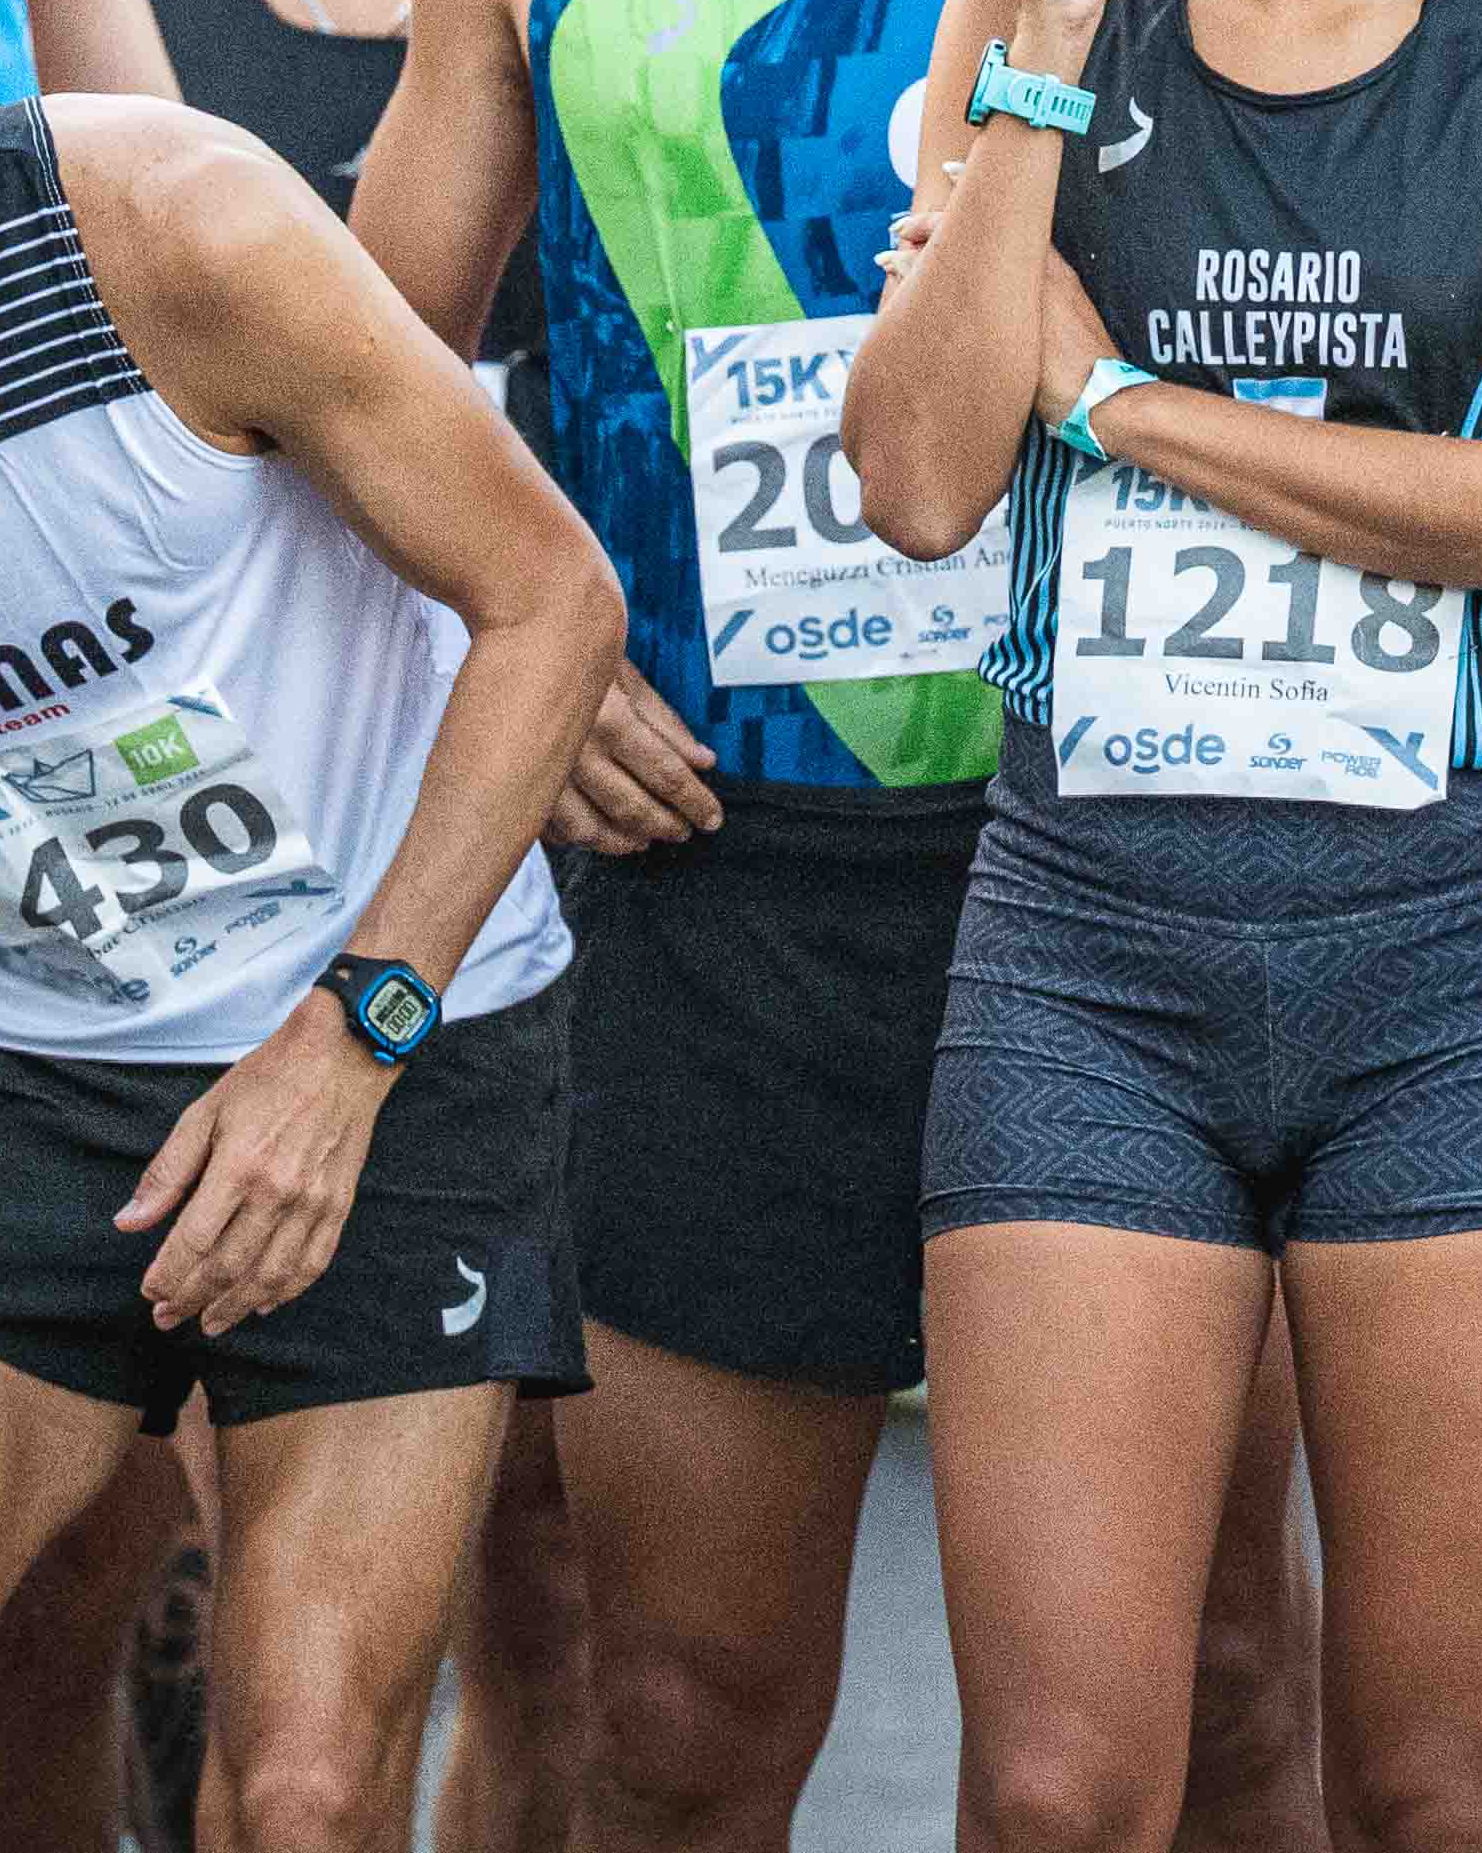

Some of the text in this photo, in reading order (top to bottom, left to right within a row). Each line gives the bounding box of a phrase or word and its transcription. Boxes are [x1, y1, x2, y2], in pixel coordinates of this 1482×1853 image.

[1195, 248, 1361, 303] ROSARIO
[1147, 309, 1407, 368] CALLEYPISTA
[727, 351, 830, 409] 15K
[713, 433, 872, 553] 20
[1104, 518, 1151, 530] PUERTO
[1157, 517, 1192, 529] NORTE
[764, 607, 893, 660] osde
[1076, 546, 1444, 673] 1218
[1166, 673, 1260, 699] Vicentin
[129, 734, 182, 772] 10K
[1103, 723, 1226, 774] osde
